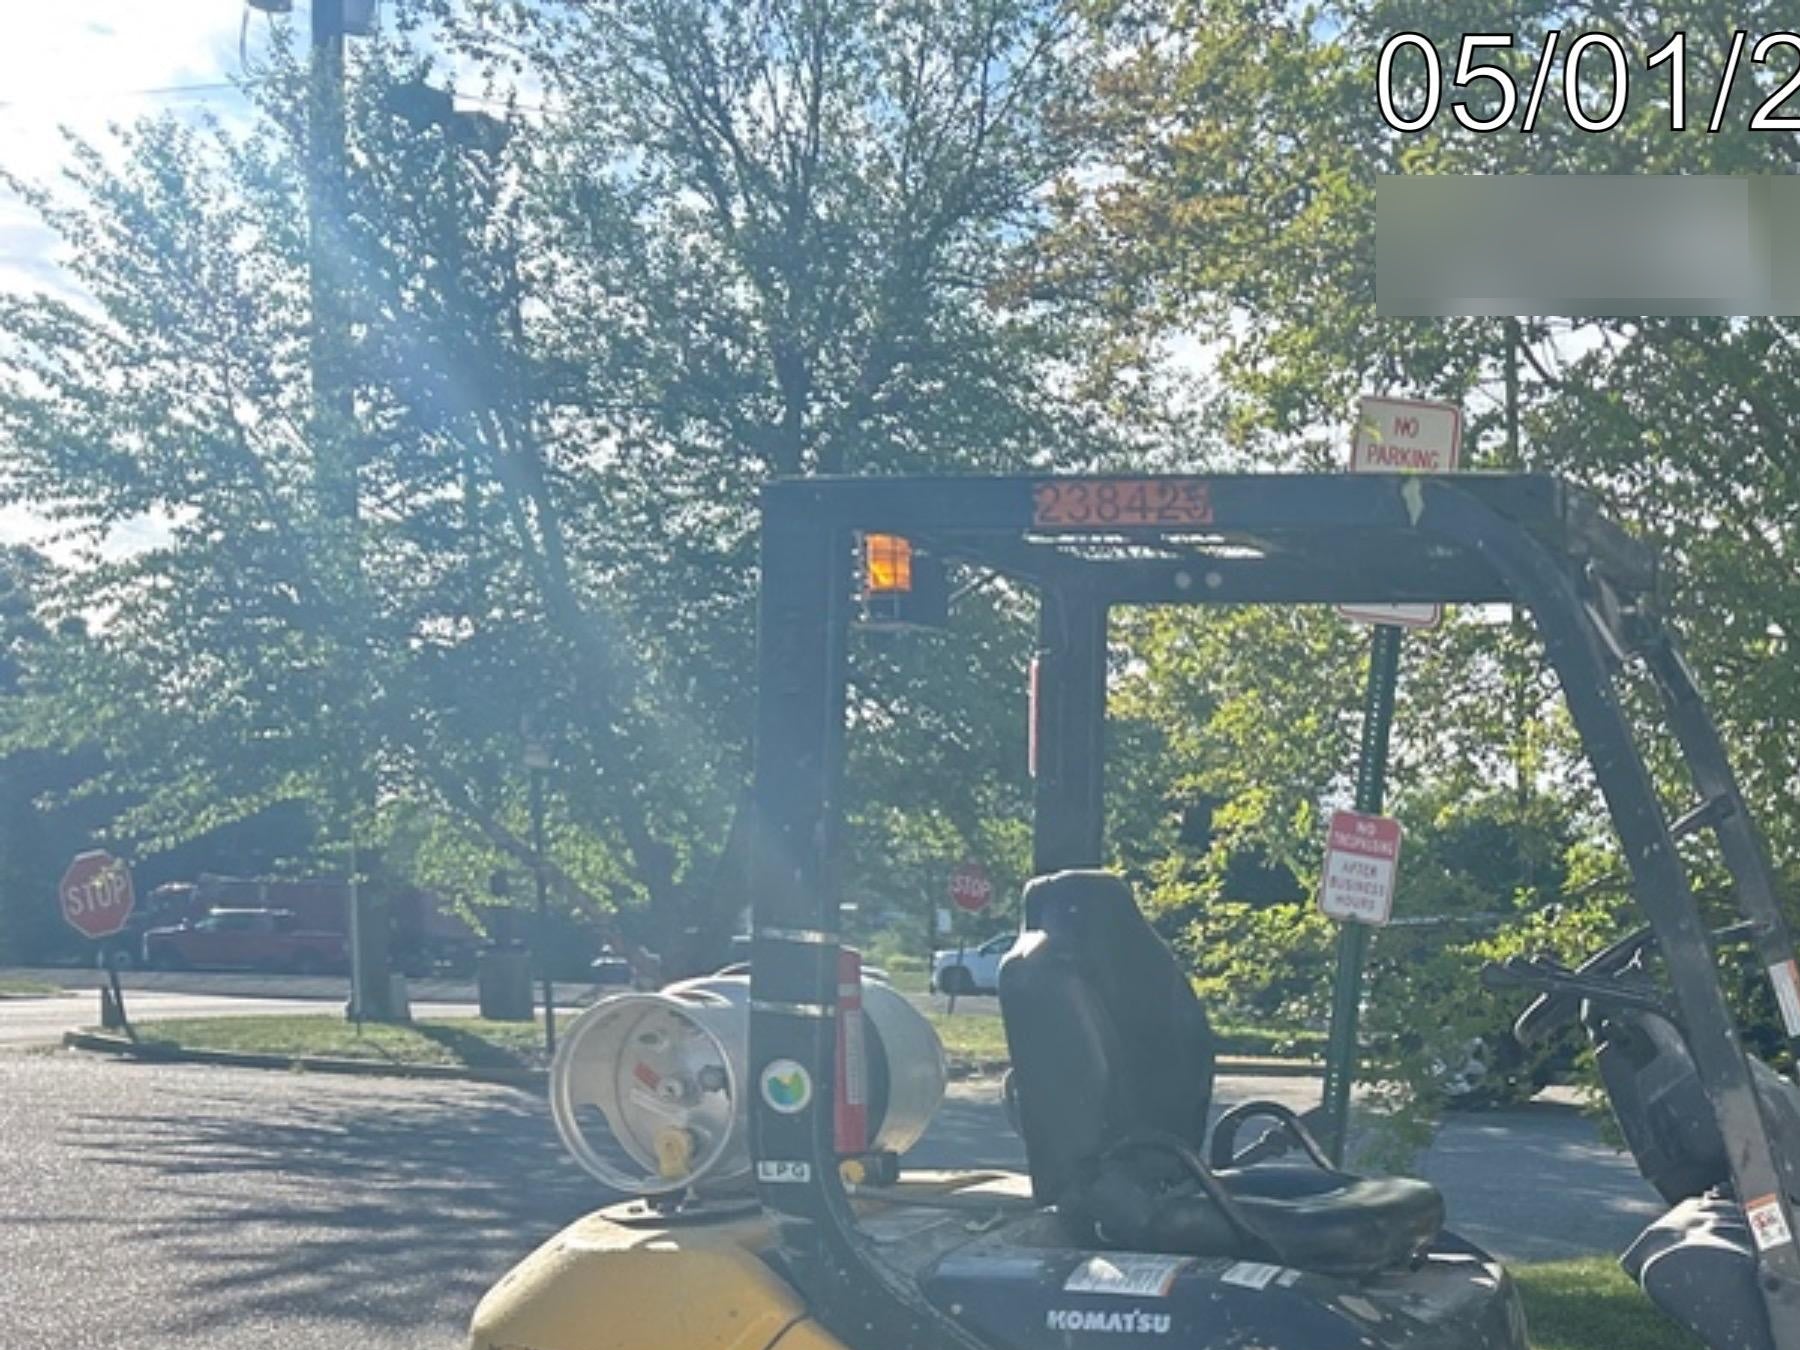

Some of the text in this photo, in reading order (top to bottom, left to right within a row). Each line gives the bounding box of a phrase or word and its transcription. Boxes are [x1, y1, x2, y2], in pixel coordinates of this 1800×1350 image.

[1394, 416, 1419, 438] NO
[1368, 444, 1439, 470] PARKING
[1355, 821, 1377, 837] NO
[68, 873, 127, 915] STOP
[953, 874, 991, 898] STOP
[1046, 1309, 1171, 1334] KOMATSU
